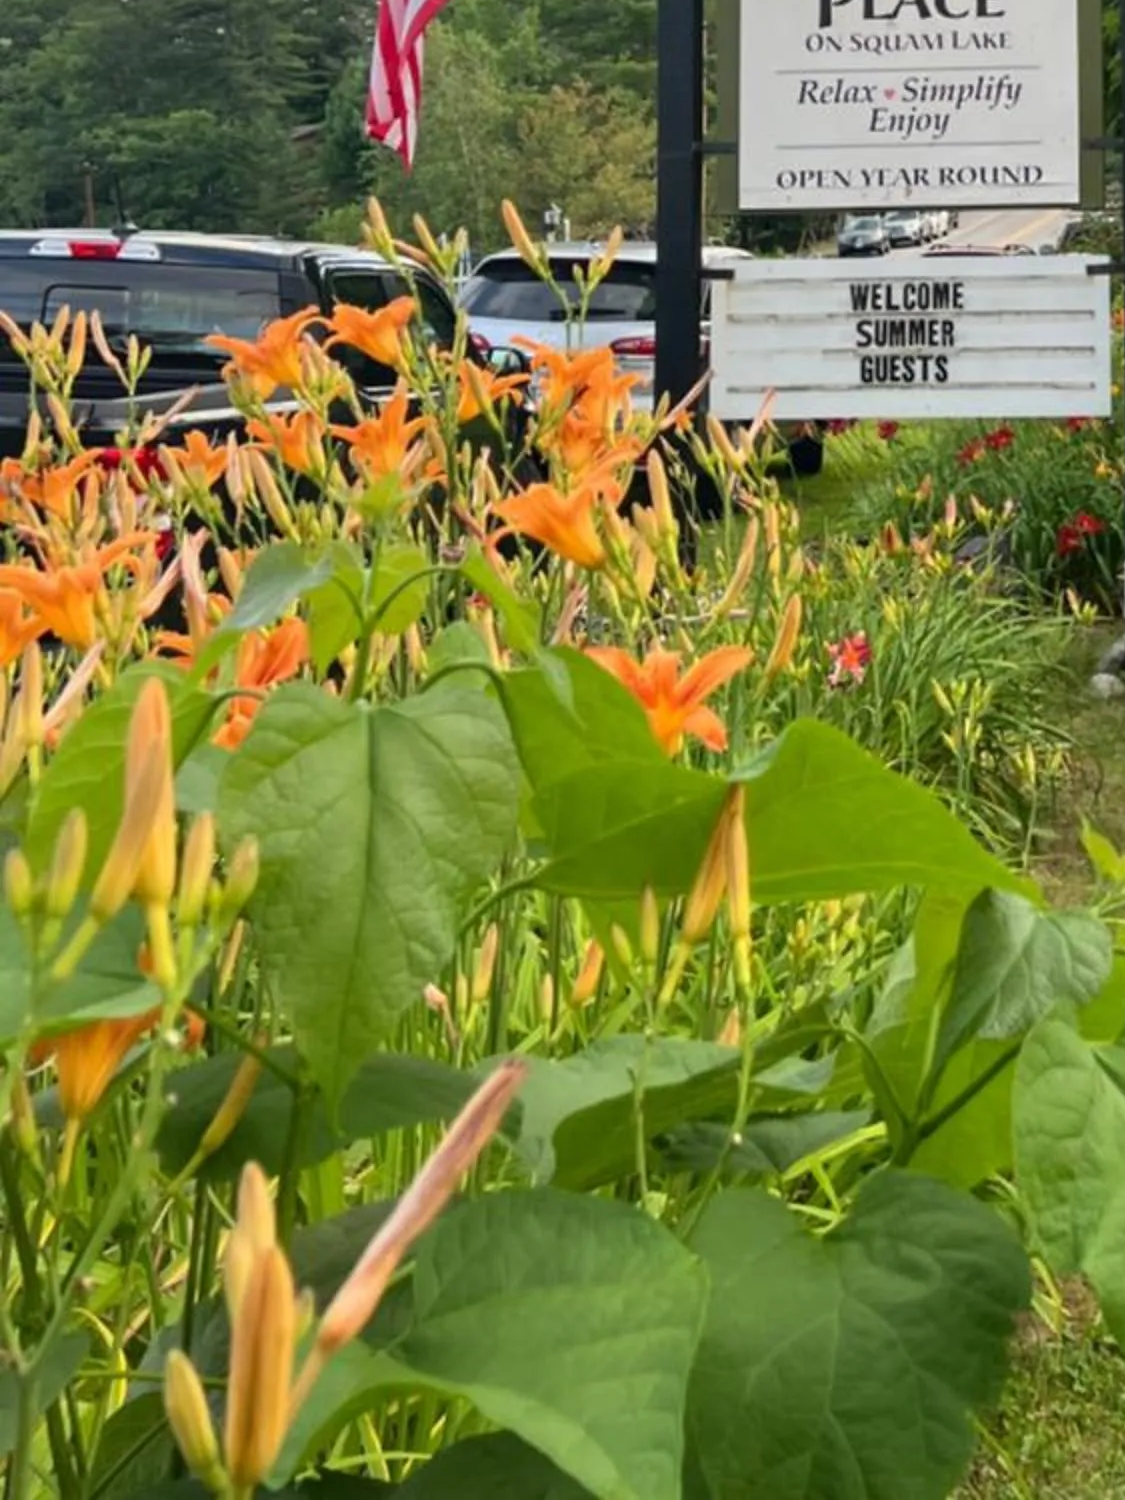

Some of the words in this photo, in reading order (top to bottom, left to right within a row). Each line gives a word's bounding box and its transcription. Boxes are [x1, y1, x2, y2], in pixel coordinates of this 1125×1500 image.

[805, 33, 842, 52] ON
[850, 32, 943, 55] SQUAM
[951, 29, 1012, 50] LAKE
[797, 78, 878, 105] Relax
[901, 74, 1022, 109] Simplify
[868, 106, 951, 140] Enjoy
[776, 168, 851, 190] OPEN
[860, 166, 930, 187] YEAR
[938, 164, 1044, 186] ROUND
[849, 282, 965, 311] WELCOME
[856, 318, 955, 348] SUMMER
[860, 353, 948, 383] GUESTS
